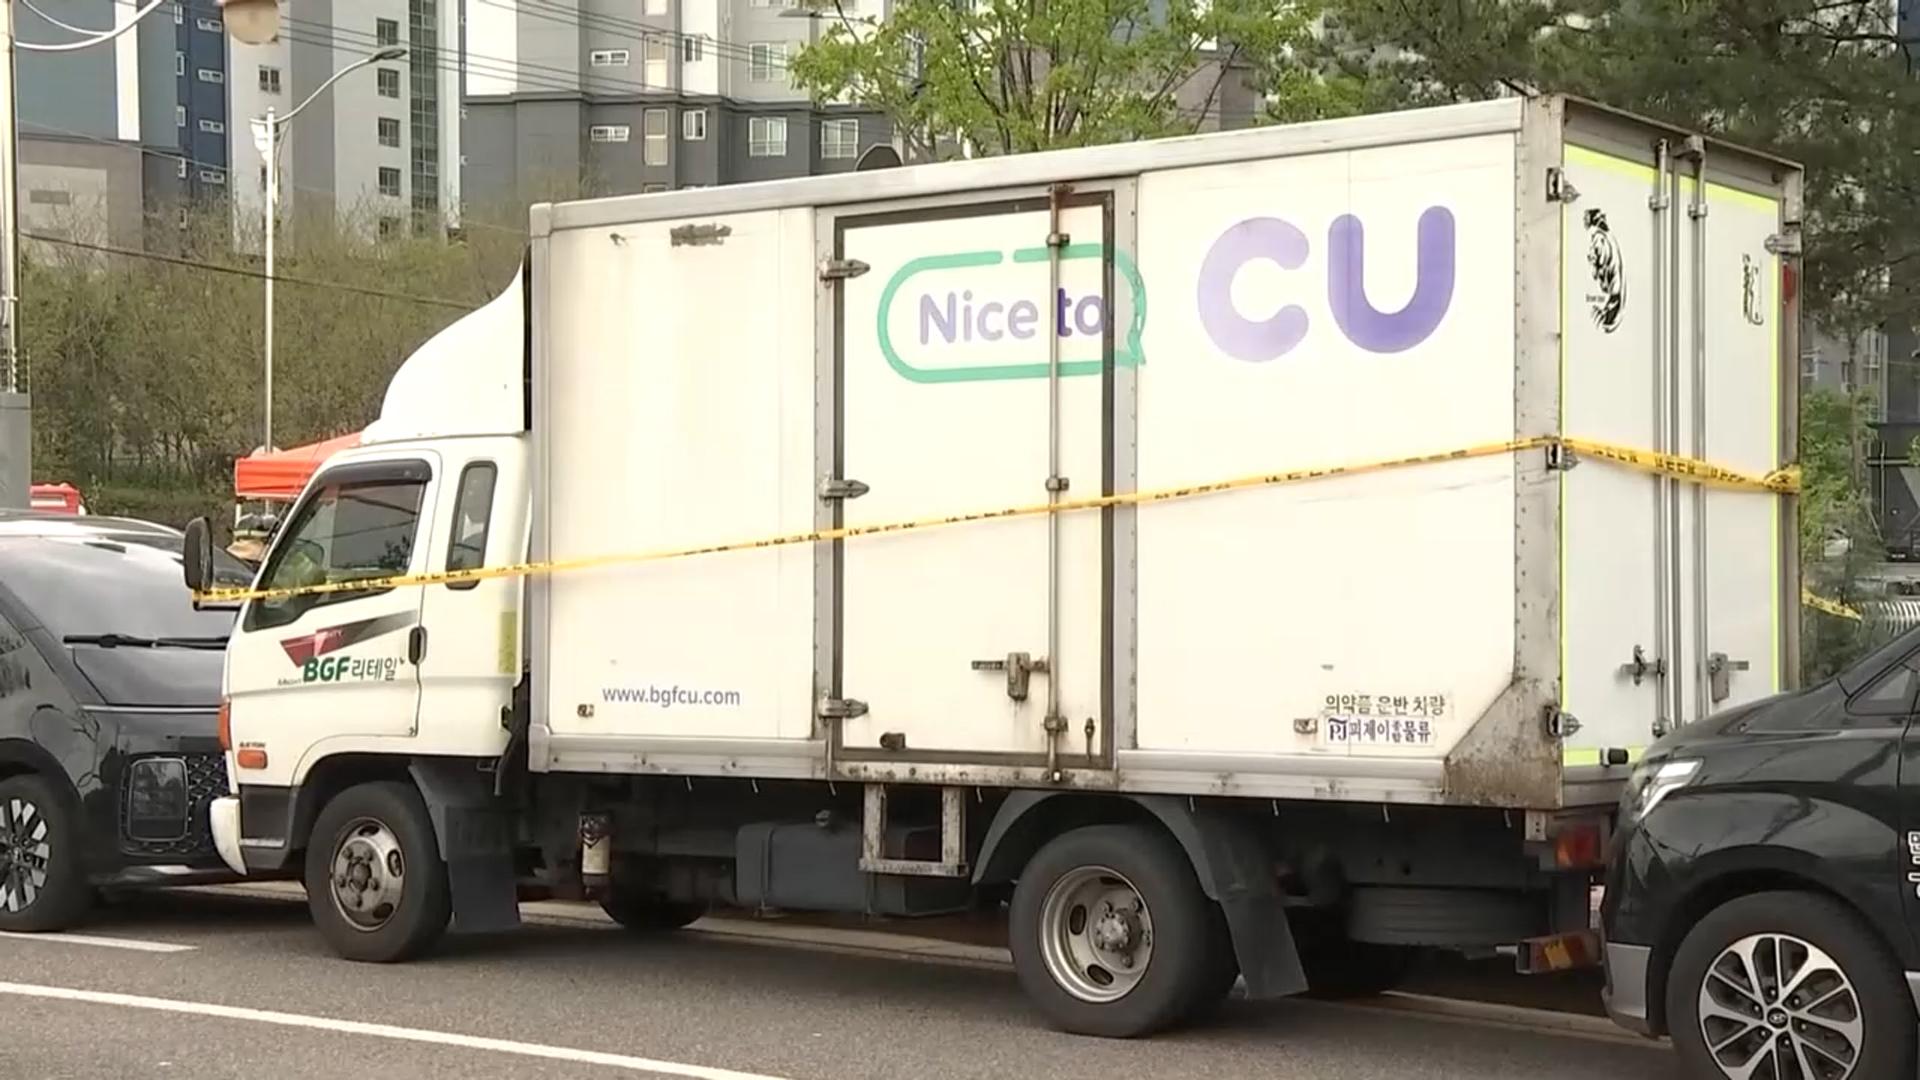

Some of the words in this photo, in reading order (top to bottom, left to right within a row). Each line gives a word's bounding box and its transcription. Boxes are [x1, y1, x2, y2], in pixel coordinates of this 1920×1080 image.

[1197, 205, 1455, 362] CU
[920, 290, 1039, 345] Nice
[1055, 287, 1103, 337] to
[602, 685, 741, 708] www.bgfcu.com
[1376, 695, 1408, 715] 운반
